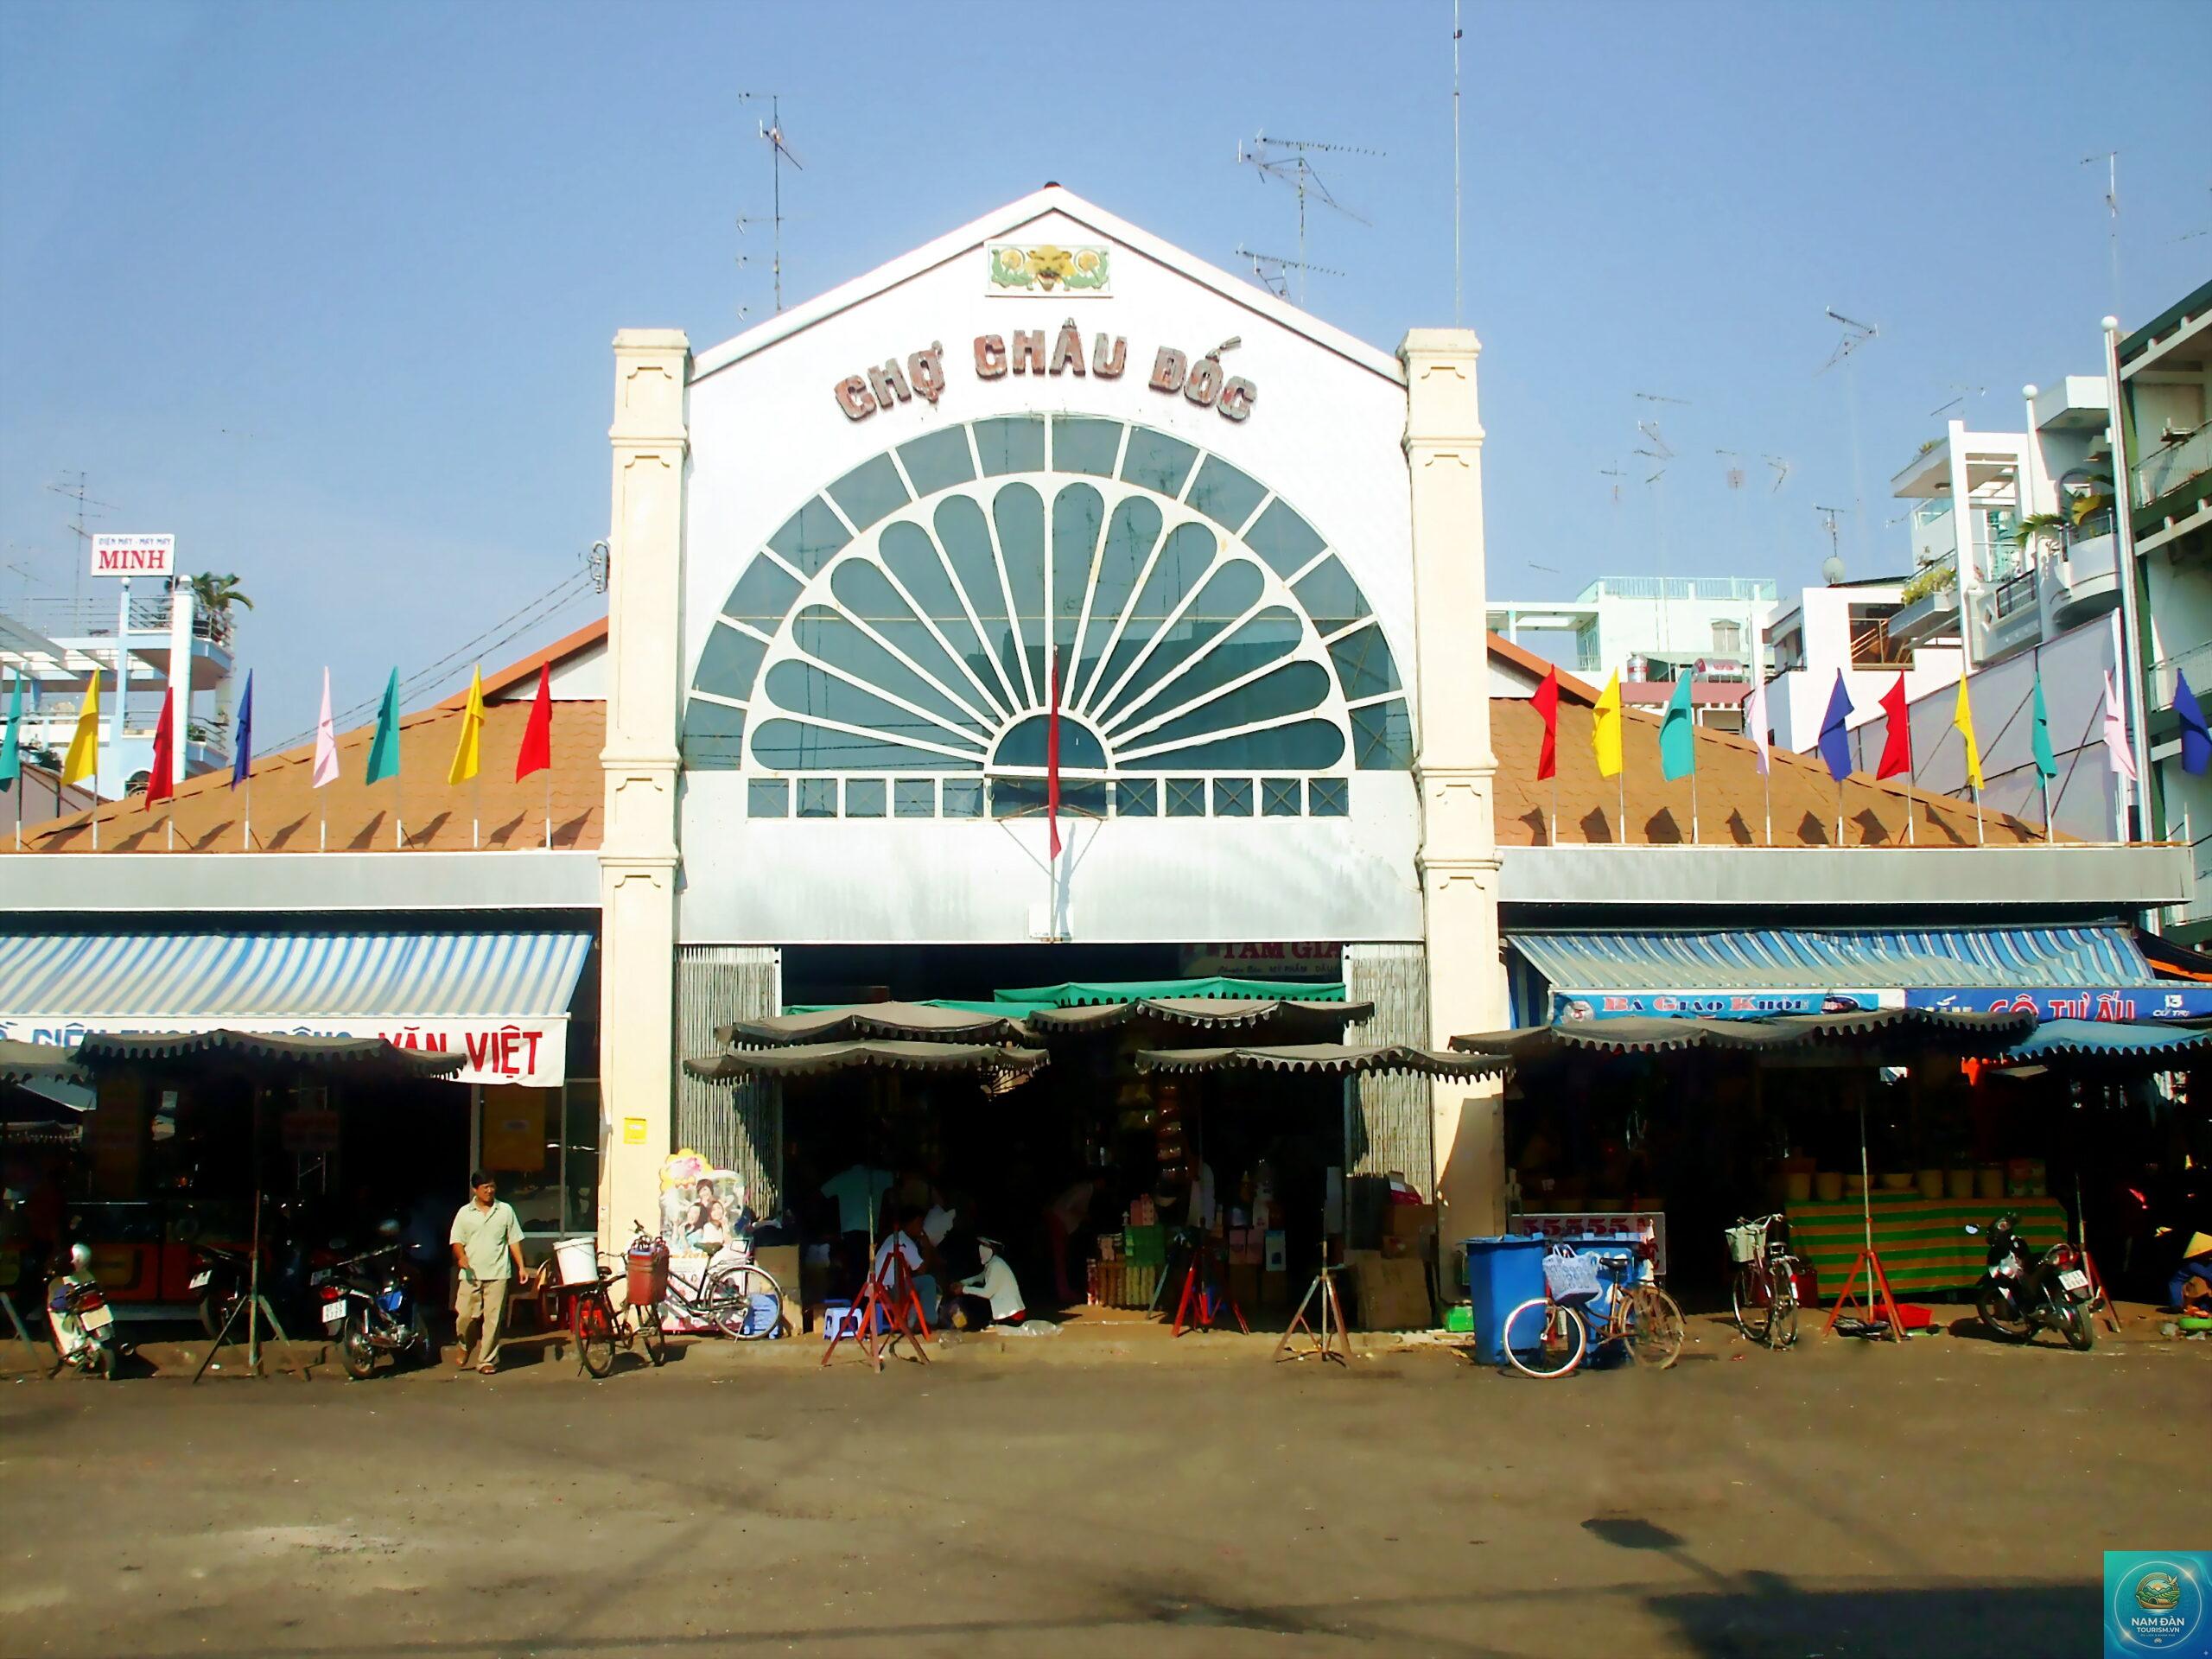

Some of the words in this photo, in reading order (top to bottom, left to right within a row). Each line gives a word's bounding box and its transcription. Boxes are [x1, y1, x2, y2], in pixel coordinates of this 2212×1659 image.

[835, 340, 944, 421] CHỢ
[973, 317, 1127, 378] CHÂU
[99, 550, 166, 569] MINH
[2164, 995, 2183, 1008] 13
[465, 1025, 543, 1078] VIỆT
